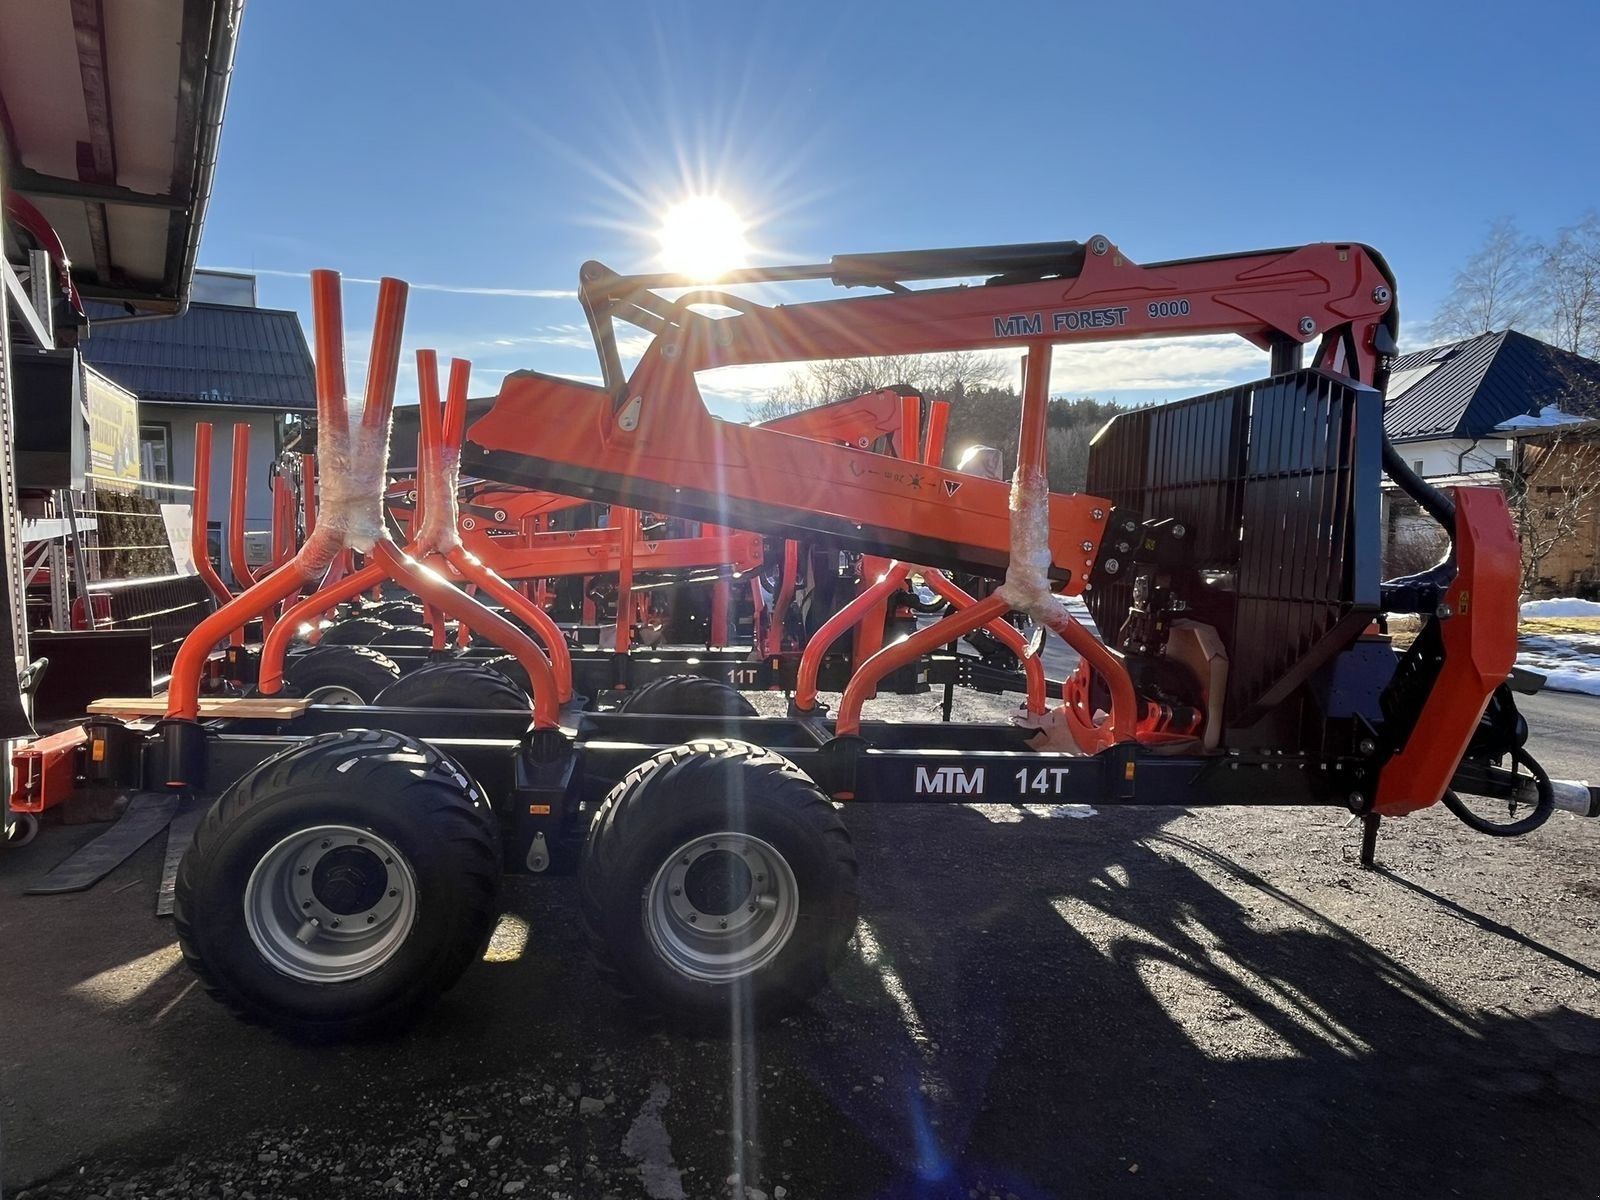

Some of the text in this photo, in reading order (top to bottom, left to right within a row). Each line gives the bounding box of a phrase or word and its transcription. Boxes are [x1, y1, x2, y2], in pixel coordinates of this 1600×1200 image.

[993, 299, 1190, 338] MTM FOREST 9000
[727, 669, 757, 684] 11T
[915, 766, 1069, 794] MTM 14T
